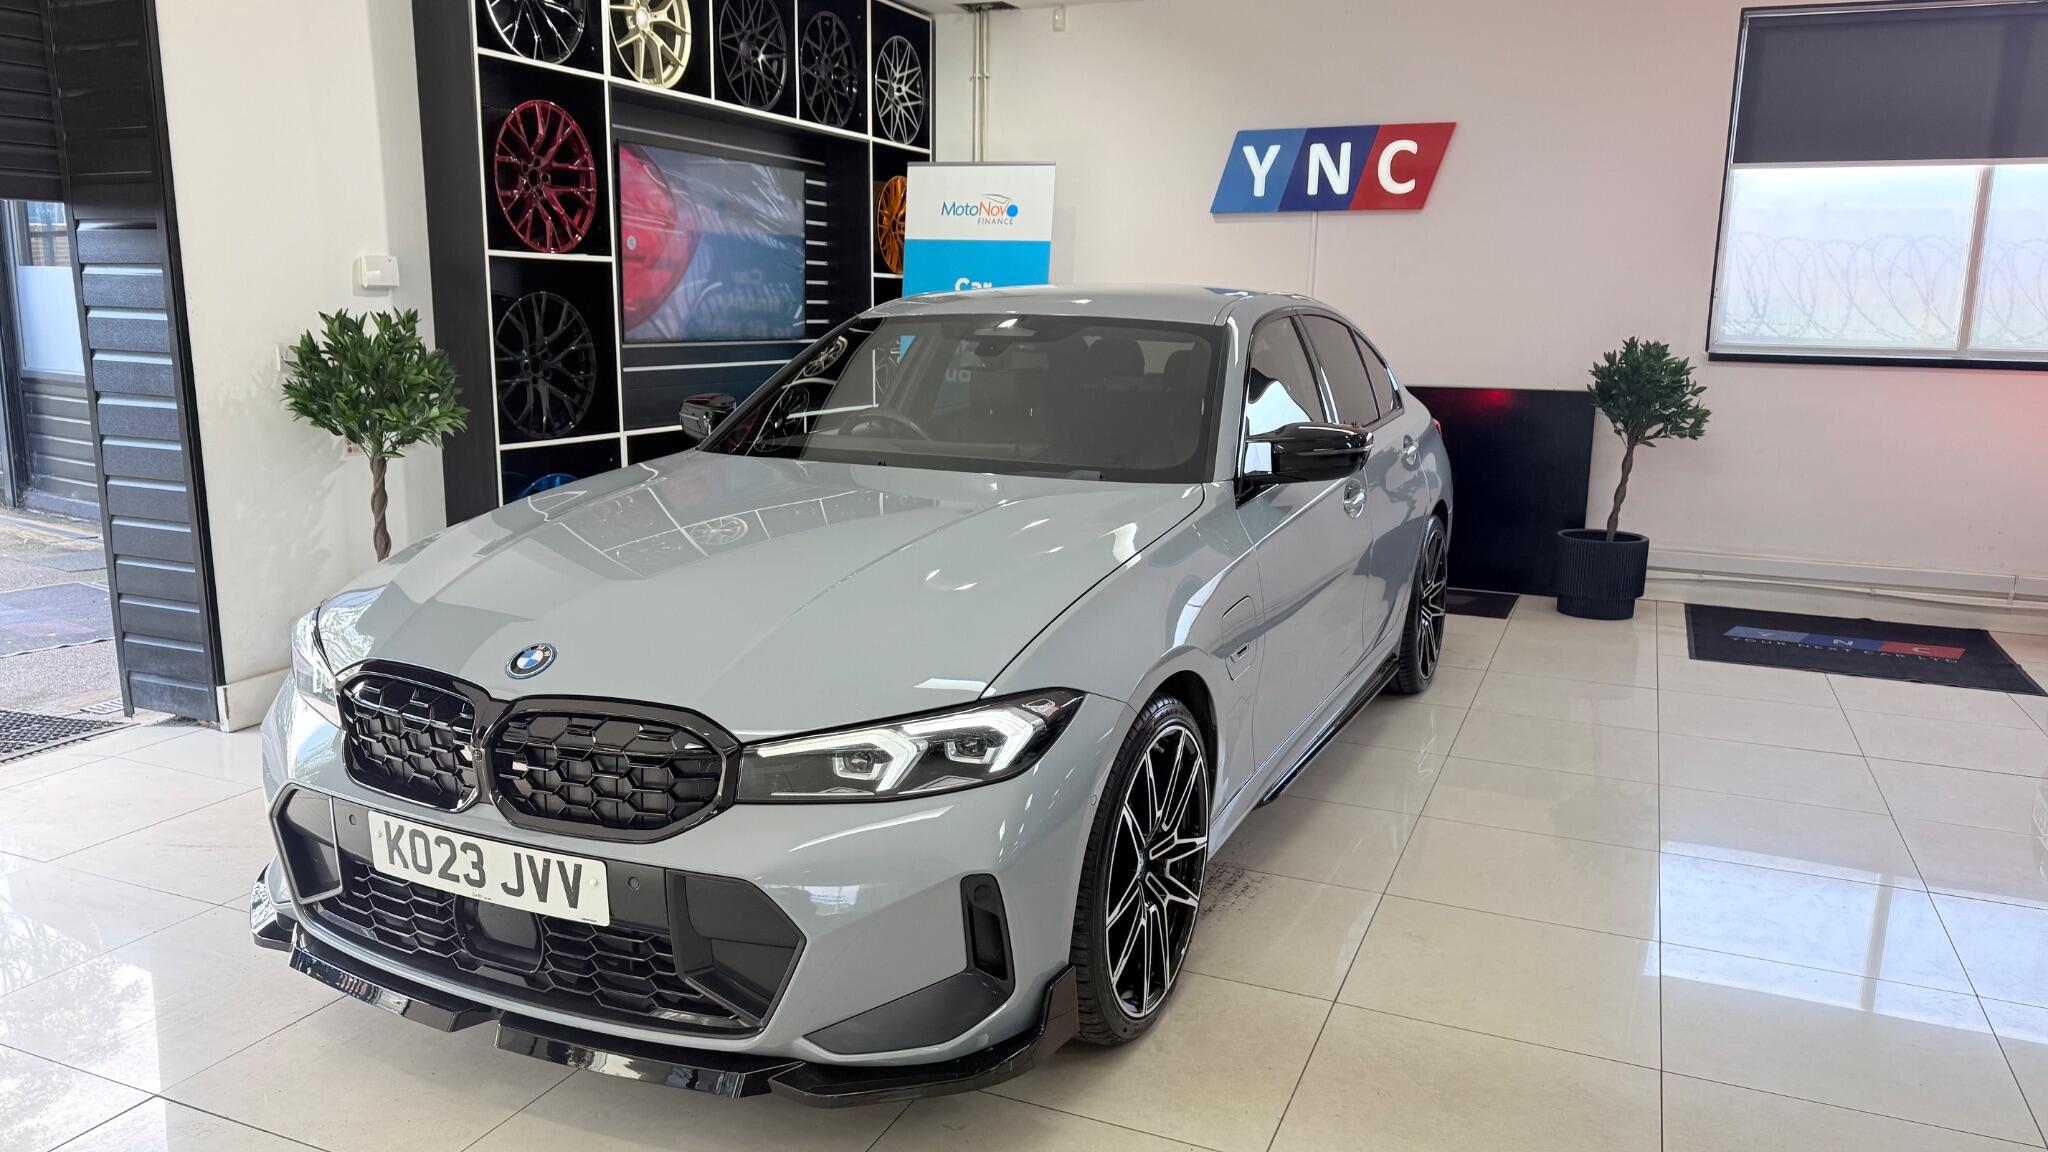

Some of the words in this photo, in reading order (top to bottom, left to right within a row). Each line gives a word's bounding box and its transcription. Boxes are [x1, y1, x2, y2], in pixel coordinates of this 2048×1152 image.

[1243, 139, 1418, 197] YNC
[977, 217, 1014, 225] FINANCE
[384, 820, 486, 889] KO23
[500, 851, 582, 909] JVV
